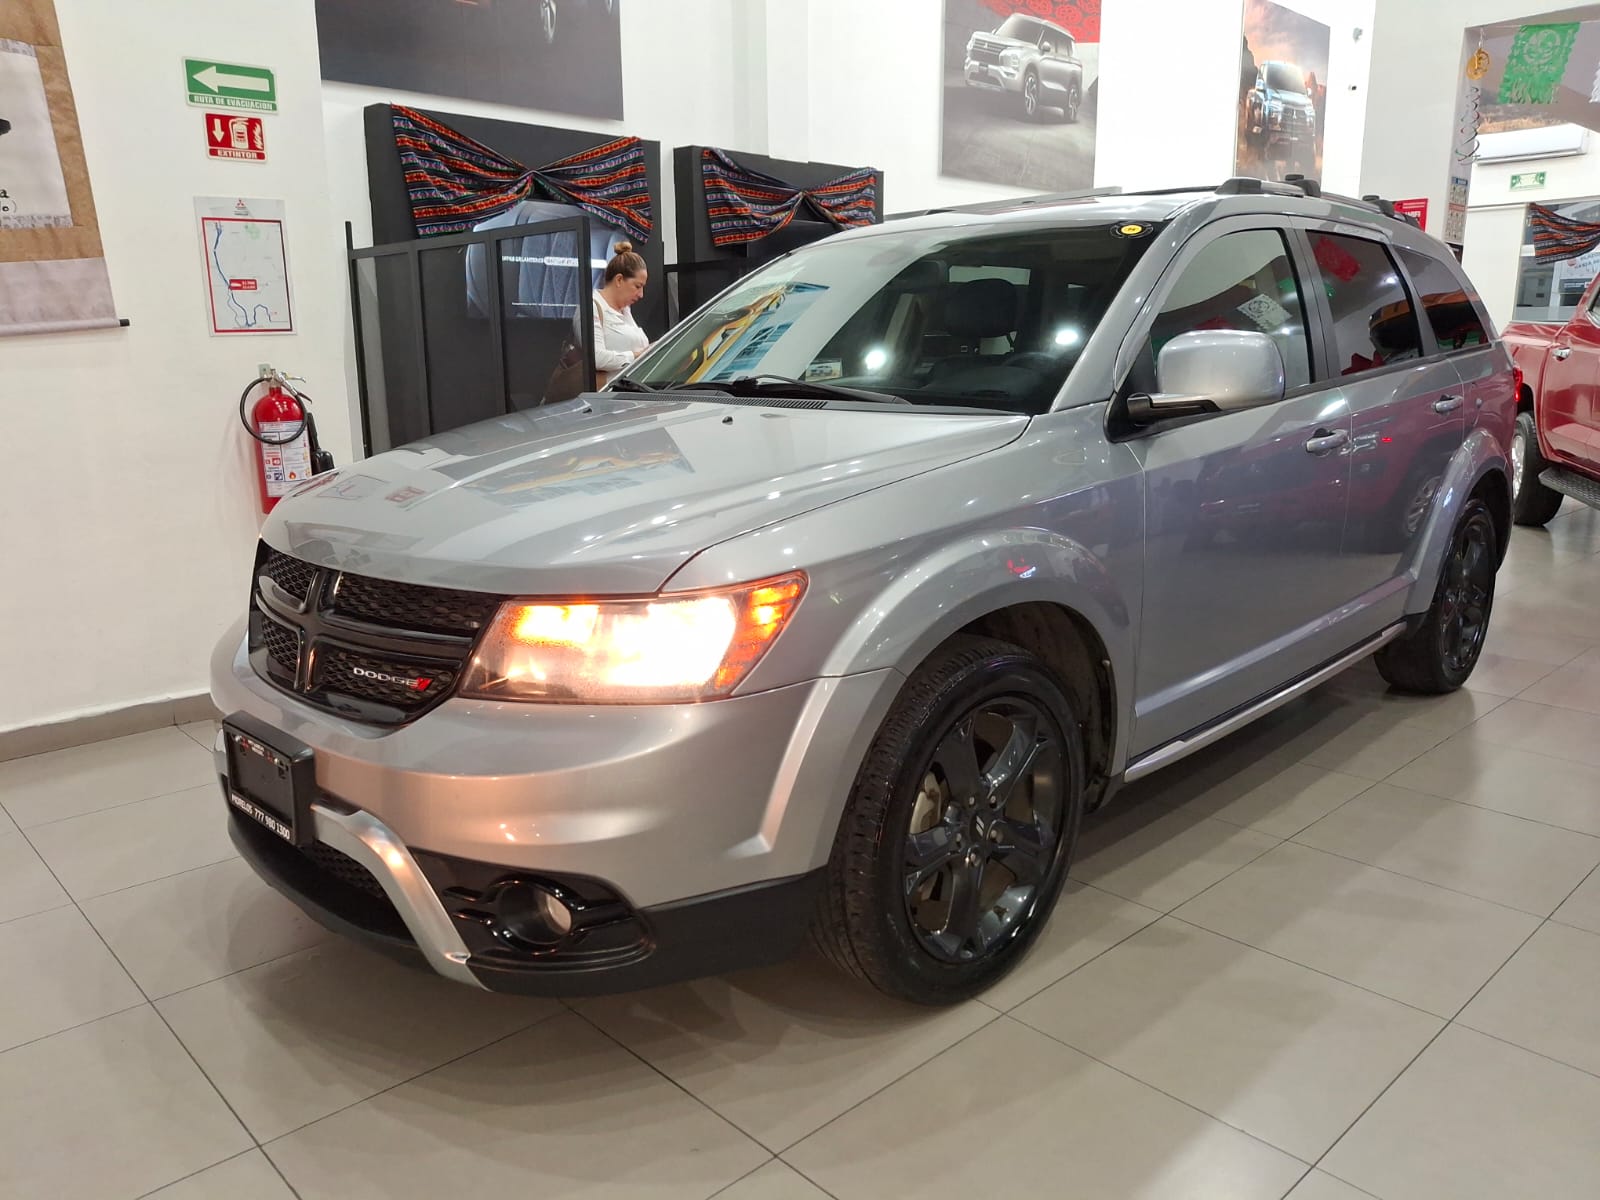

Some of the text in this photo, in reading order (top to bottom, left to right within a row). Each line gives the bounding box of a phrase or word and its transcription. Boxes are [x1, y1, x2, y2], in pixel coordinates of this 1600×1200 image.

[194, 95, 213, 104] RUTA
[215, 97, 226, 106] DE
[217, 149, 258, 160] EXTINTOR
[353, 667, 418, 687] DODGE
